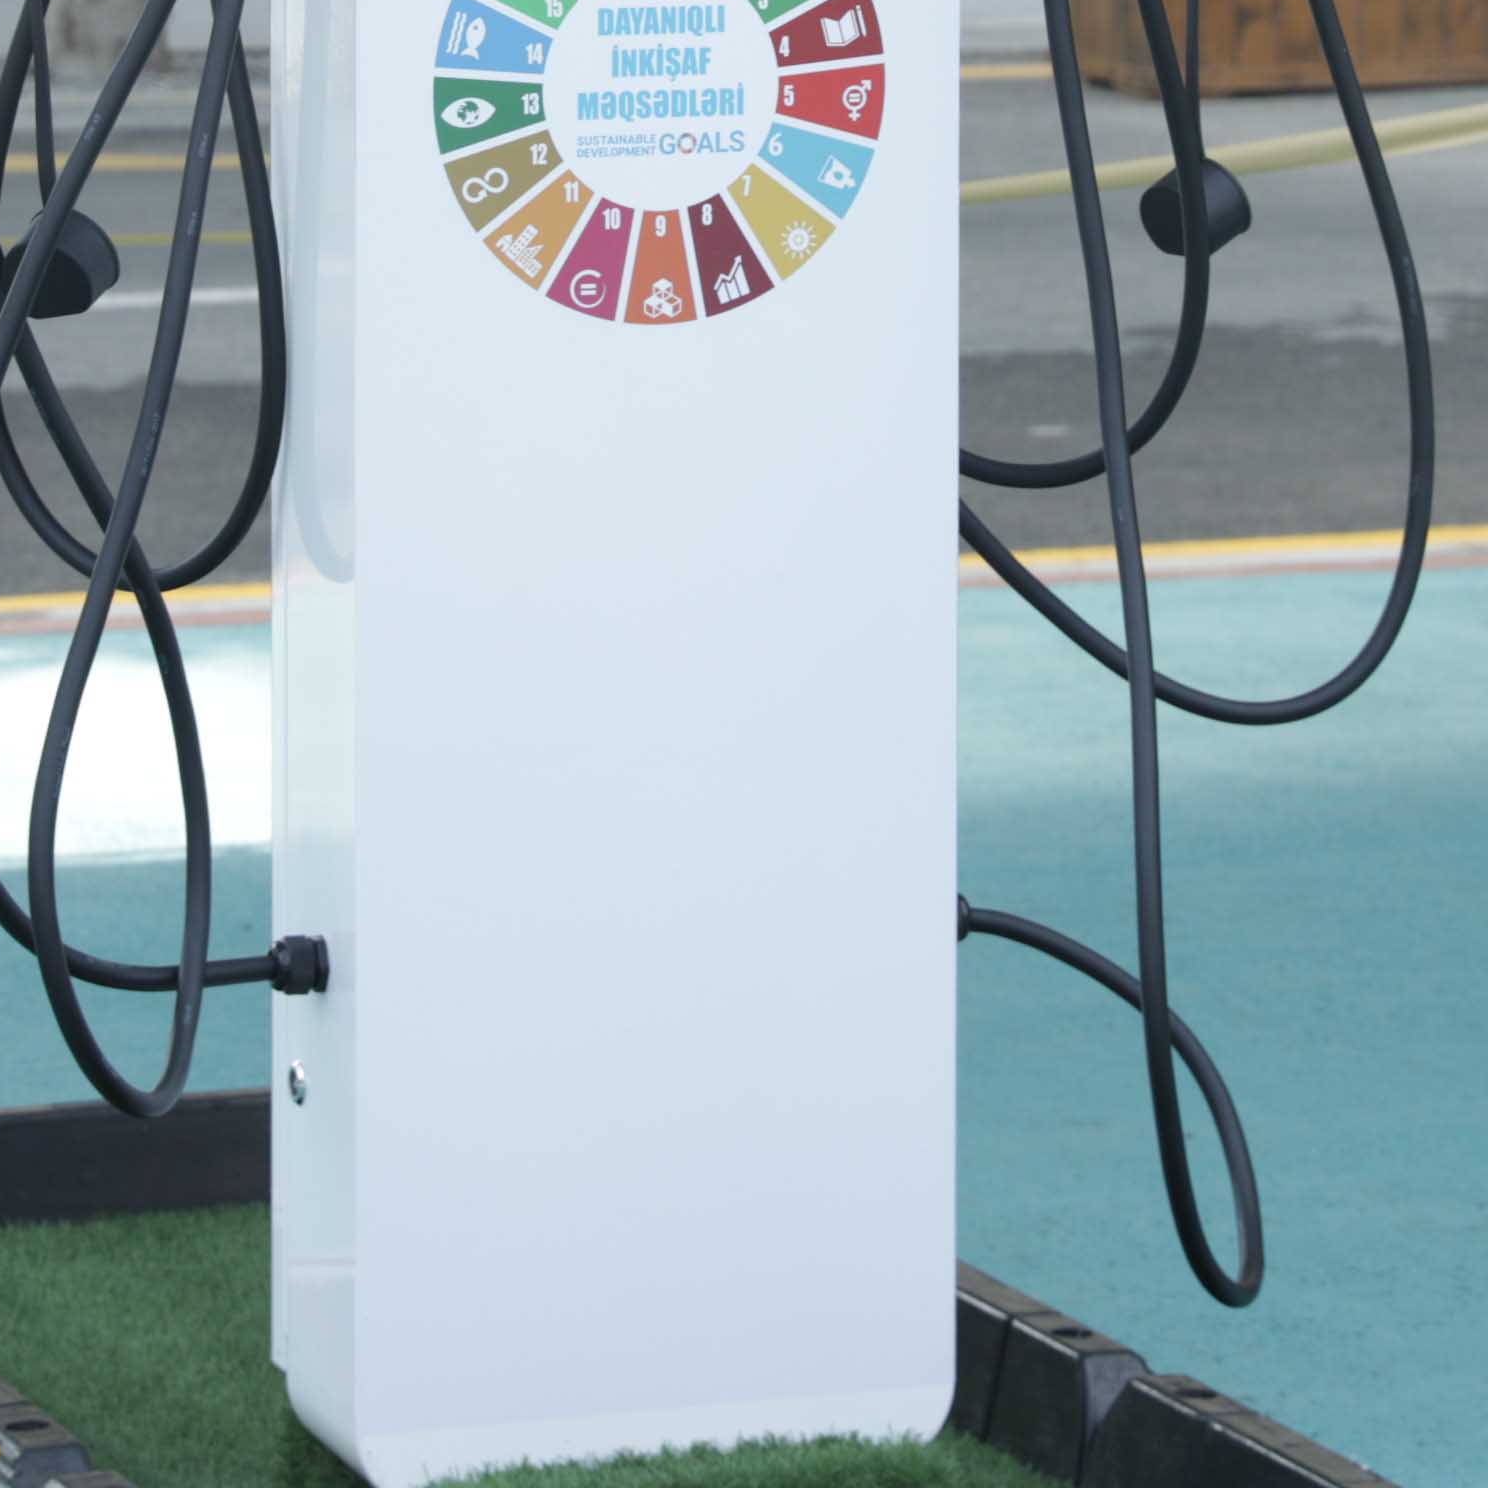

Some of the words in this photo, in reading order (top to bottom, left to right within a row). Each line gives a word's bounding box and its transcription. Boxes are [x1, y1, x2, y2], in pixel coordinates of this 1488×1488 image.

[597, 5, 725, 36] DAYANIQLI
[527, 43, 543, 64] 14
[779, 36, 789, 56] 4
[612, 43, 711, 82] İNKİŞAF
[522, 93, 539, 114] 13
[577, 82, 744, 122] MƏQSƏDLƏRİ
[784, 85, 794, 106] 5
[577, 134, 656, 146] SUSTAINABLE
[659, 130, 745, 155] GOALS
[769, 134, 783, 156] 6
[531, 143, 547, 164] 12
[577, 146, 656, 158] DEVELOPMENT
[565, 181, 578, 202] 11
[742, 174, 751, 196] 7
[603, 208, 620, 229] 10
[702, 204, 712, 225] 8
[656, 215, 666, 236] 9
